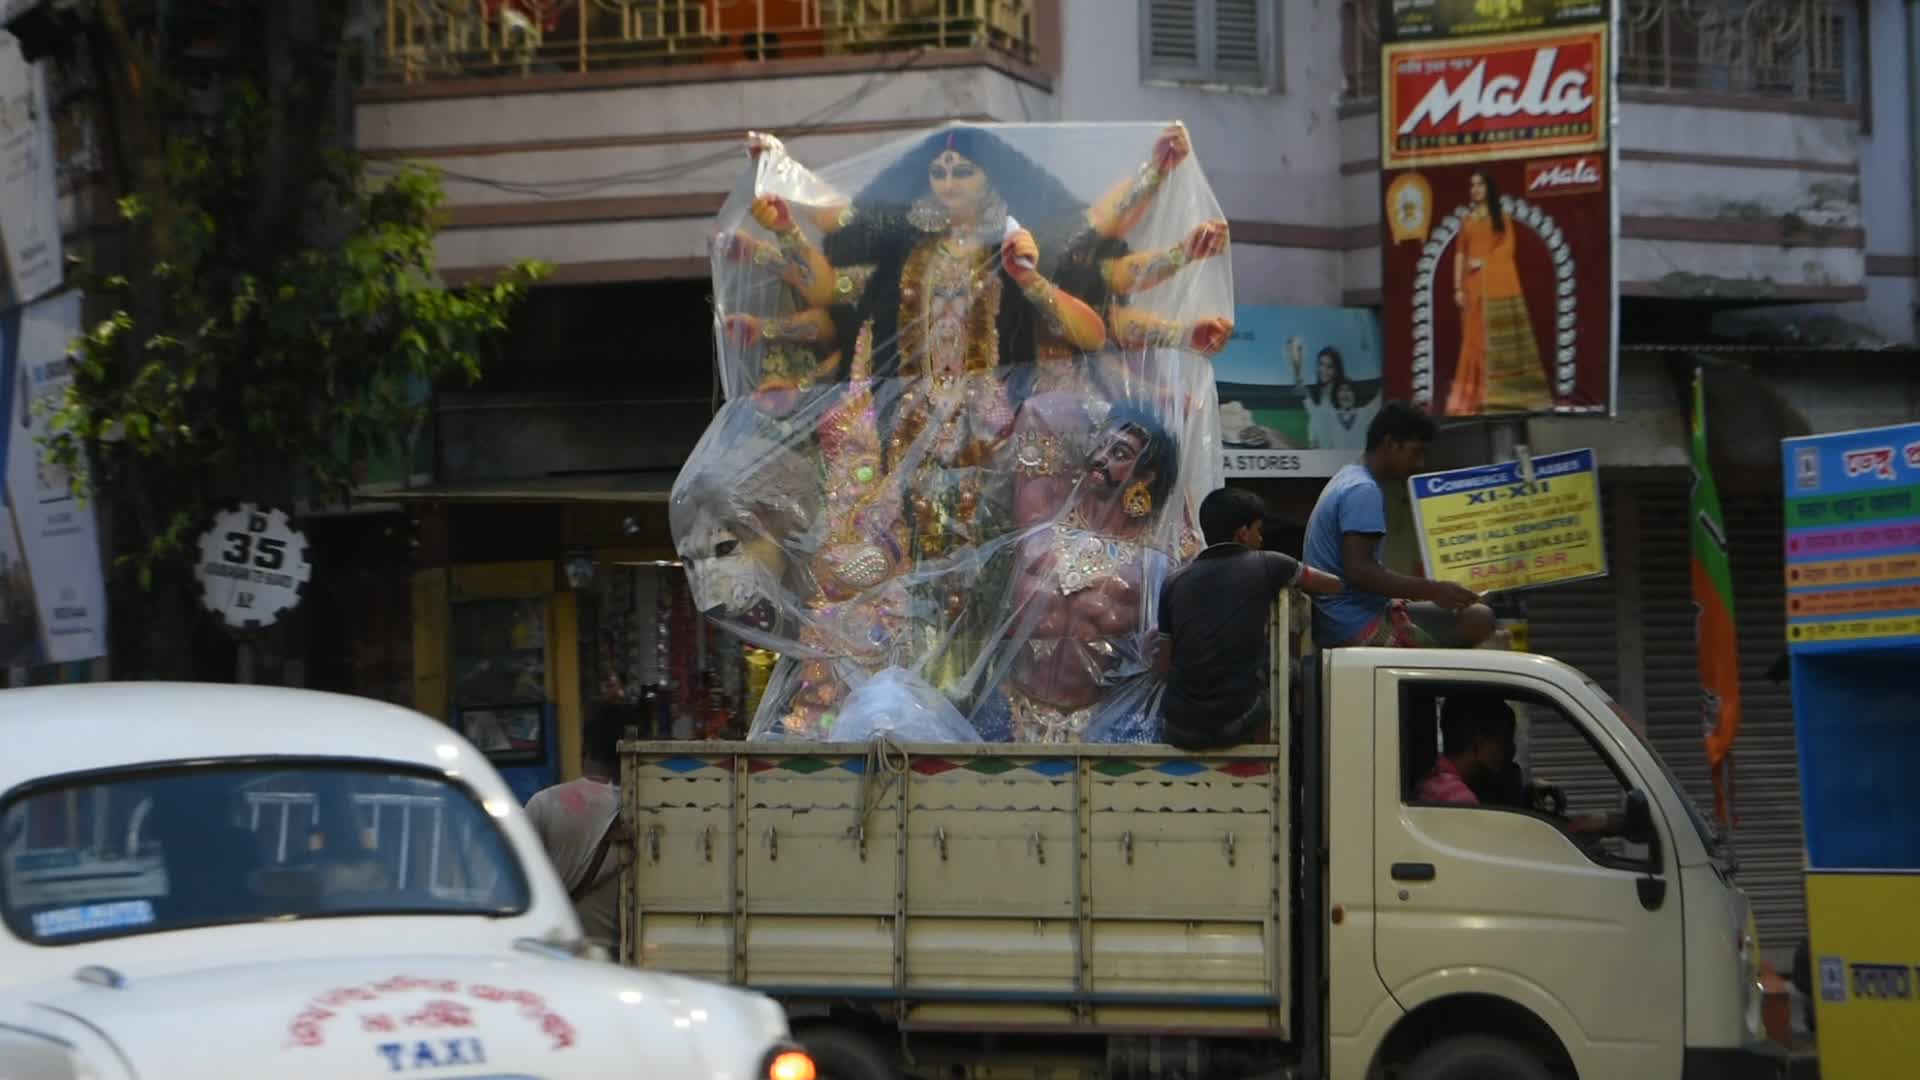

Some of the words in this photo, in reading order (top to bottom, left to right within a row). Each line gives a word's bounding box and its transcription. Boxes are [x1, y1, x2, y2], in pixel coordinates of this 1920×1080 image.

[1398, 48, 1595, 134] Mala
[1529, 159, 1600, 191] Mala
[1236, 455, 1302, 471] STORES
[222, 531, 288, 570] 35
[1470, 559, 1526, 578] RAJA
[1534, 551, 1569, 569] SIR
[376, 1037, 486, 1071] TAXI
